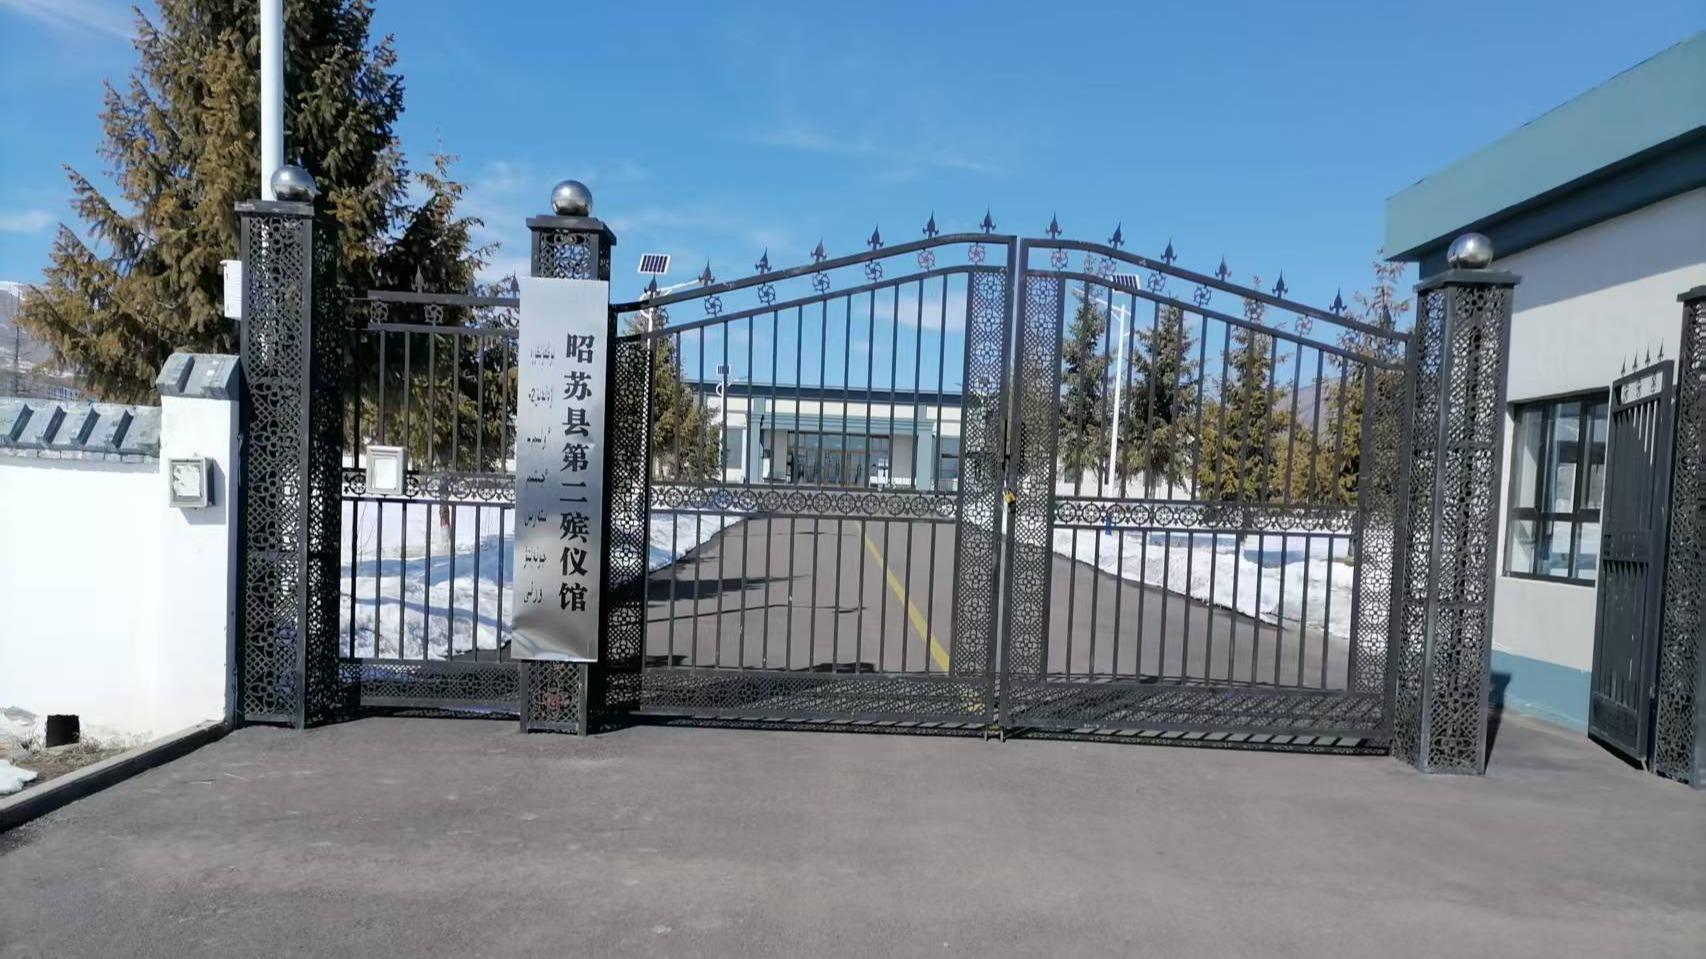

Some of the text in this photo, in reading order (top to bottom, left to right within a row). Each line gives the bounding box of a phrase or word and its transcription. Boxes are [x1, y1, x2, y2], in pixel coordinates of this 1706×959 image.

[558, 333, 595, 612] 昭苏县第二殡仪馆
